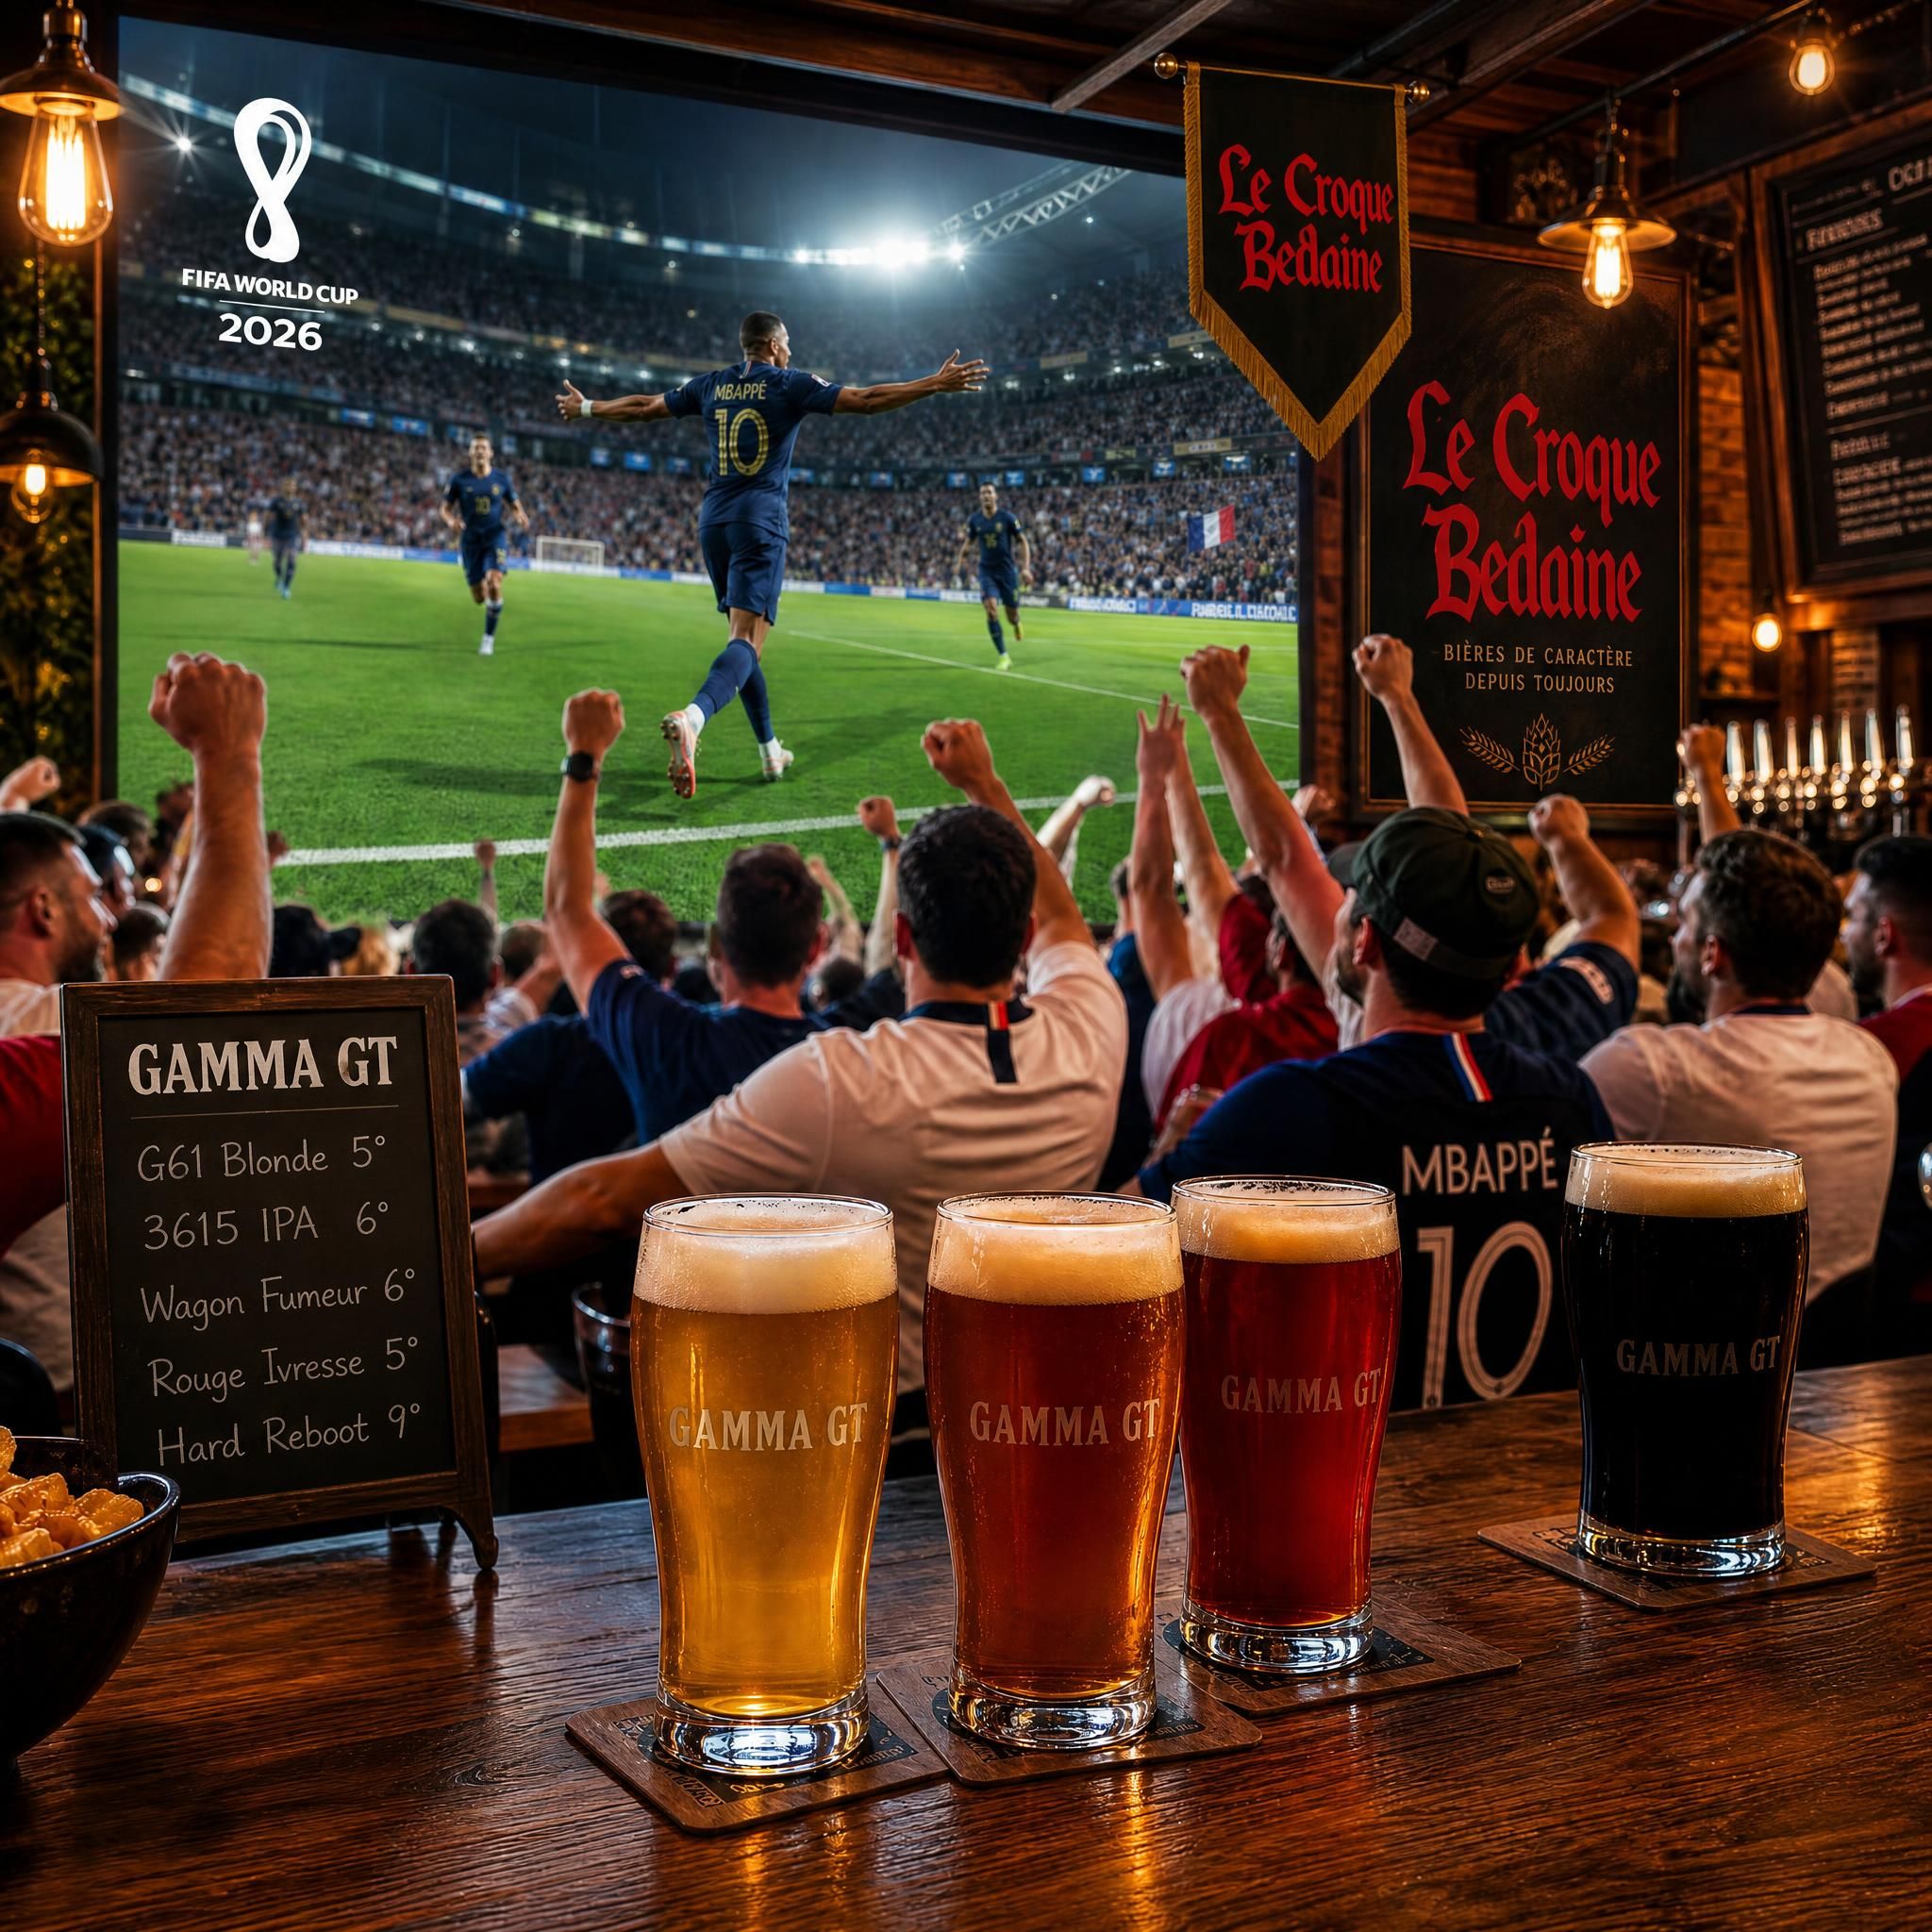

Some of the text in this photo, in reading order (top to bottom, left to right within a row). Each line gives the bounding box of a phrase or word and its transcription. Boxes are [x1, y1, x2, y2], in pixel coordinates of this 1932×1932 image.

[1219, 143, 1393, 238] Le Croque
[1234, 219, 1385, 292] Bedaine
[182, 269, 358, 305] FIFA WORLD CUP
[219, 312, 323, 351] 2026
[715, 380, 767, 400] MBAPPÉ
[715, 408, 769, 475] 10
[1404, 380, 1660, 529] Le Croque
[1422, 502, 1641, 623] Bedaine
[1444, 640, 1632, 666] BIÈRES DE CARACTÈRE
[1466, 673, 1613, 692] DEPUIS TOUJOURS
[128, 1037, 397, 1095] GAMMA GT
[138, 1136, 385, 1181] G61 Blonde 5°
[1403, 1126, 1557, 1194] MBAPPÉ
[144, 1202, 388, 1250] 3615 IPA 6°
[141, 1269, 414, 1331] Wagon Fumeur 6°
[1418, 1221, 1554, 1409] 10
[147, 1337, 418, 1403] Rouge Ivresse 5°
[1617, 1336, 1780, 1376] GAMMA GT
[1222, 1368, 1382, 1414] GAMMA GT
[158, 1404, 420, 1466] Hard Reboot 9°
[670, 1403, 867, 1451] GAMMA GT
[971, 1398, 1159, 1446] GAMMA GT
